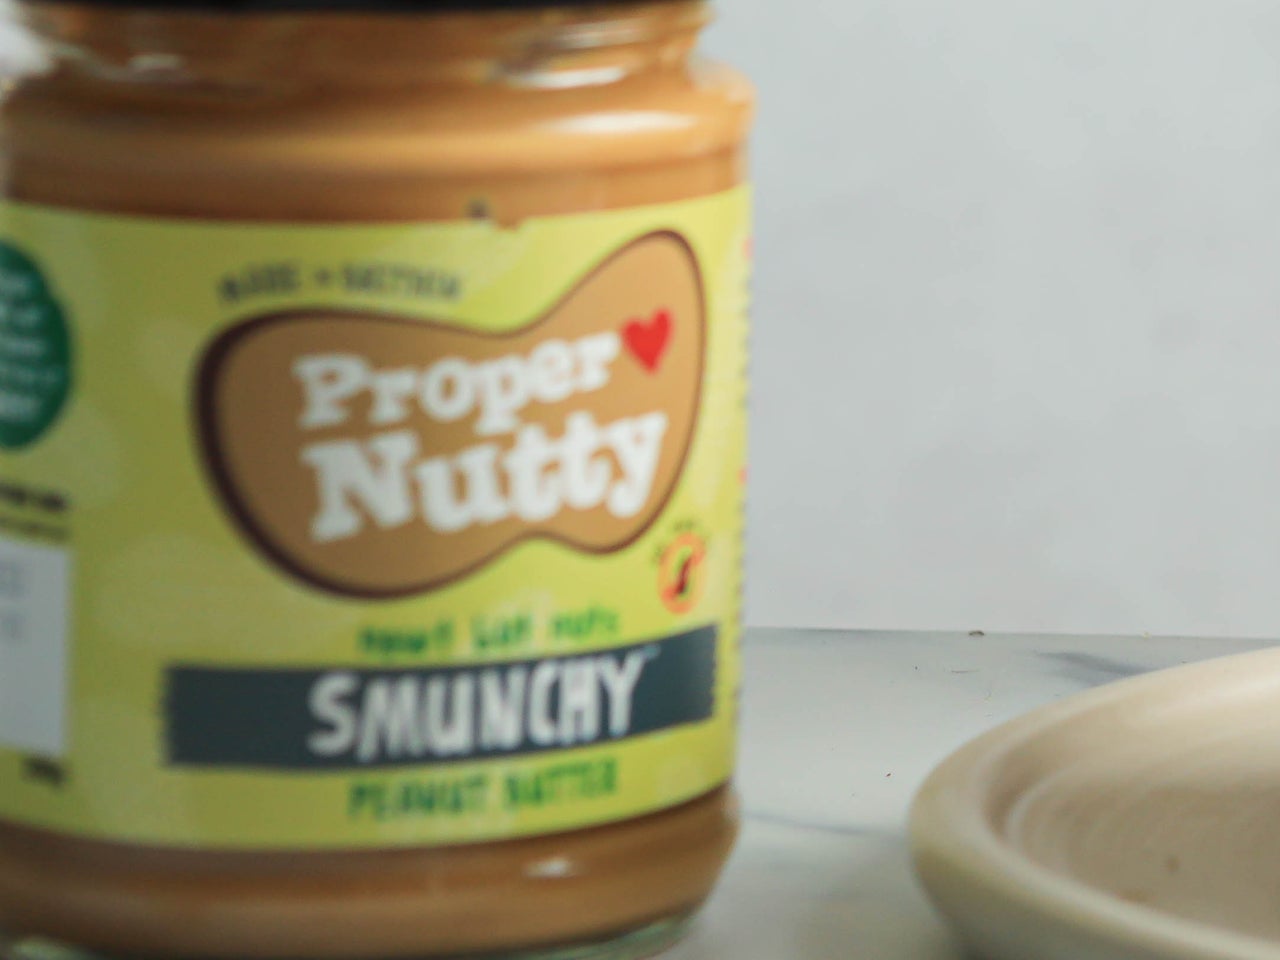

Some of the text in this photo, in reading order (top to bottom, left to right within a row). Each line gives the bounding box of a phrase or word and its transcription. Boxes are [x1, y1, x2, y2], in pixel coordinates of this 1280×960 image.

[294, 331, 620, 436] Proper
[303, 411, 669, 543] Nutty
[307, 647, 647, 763] SMUNCHY
